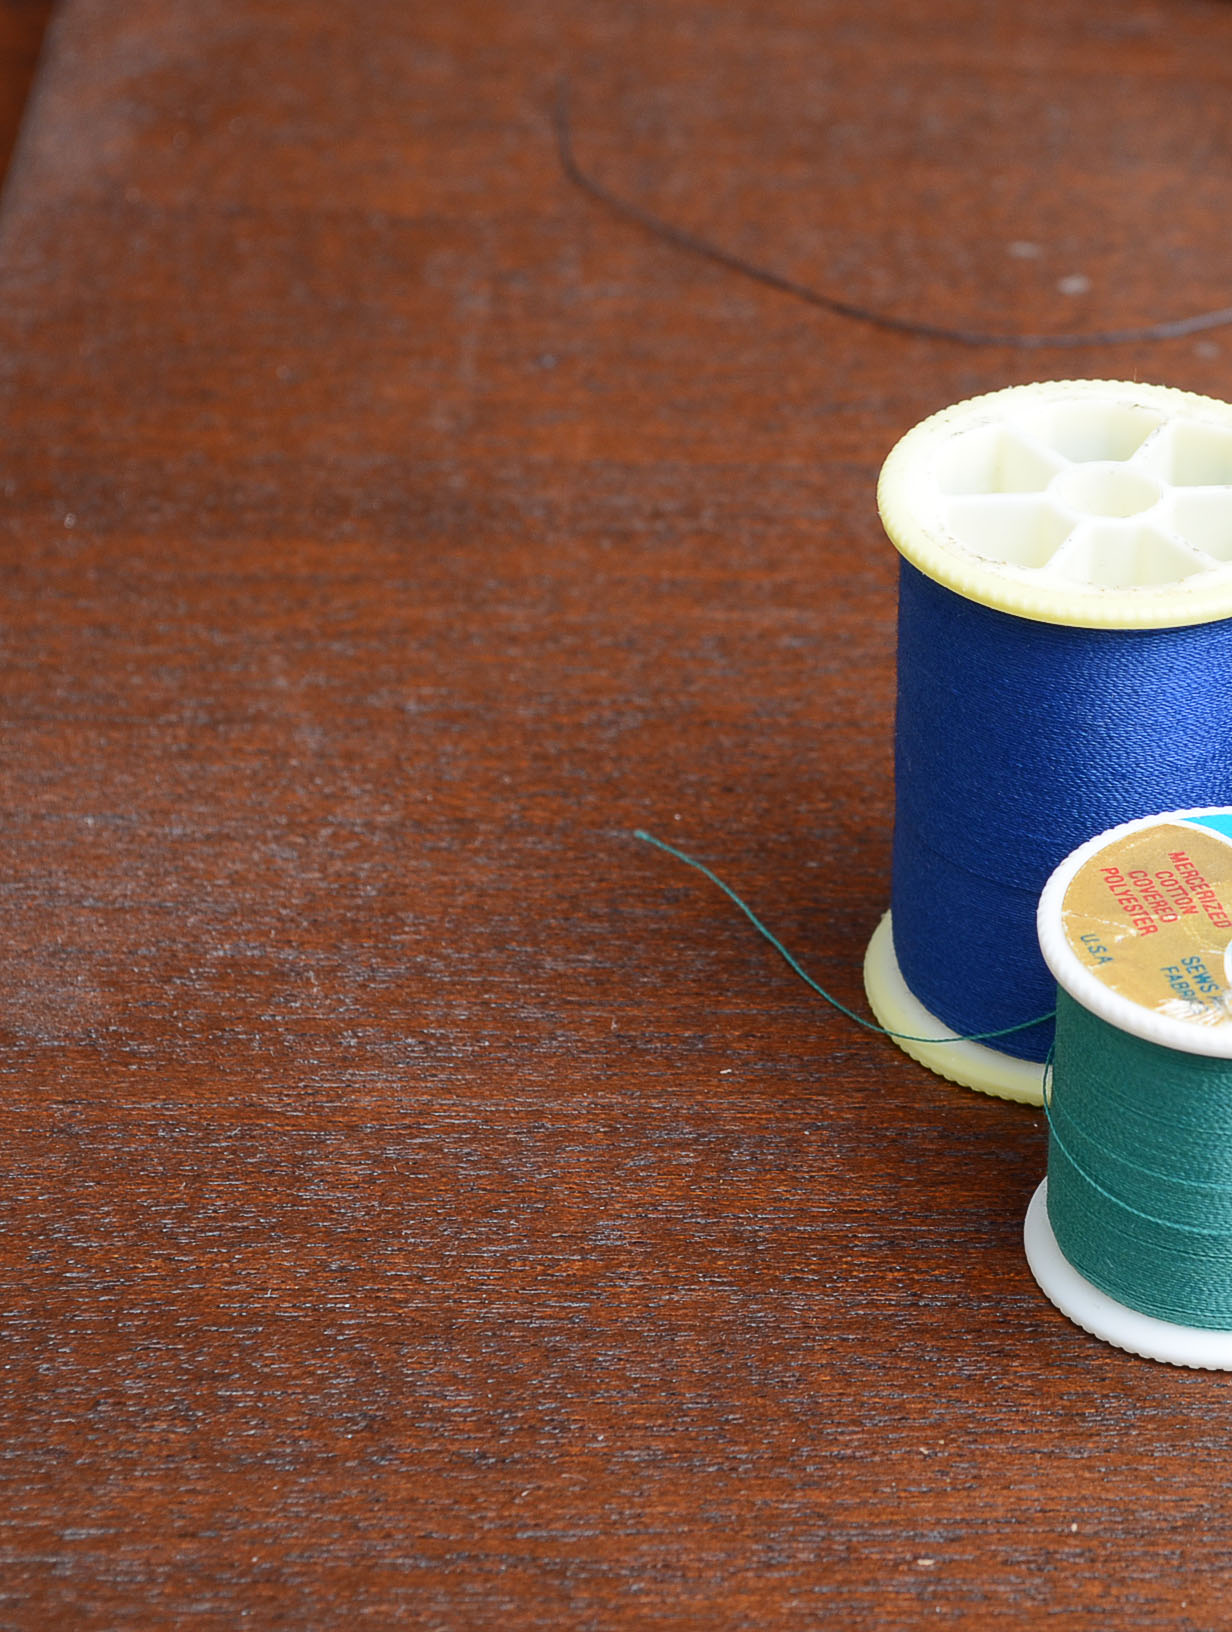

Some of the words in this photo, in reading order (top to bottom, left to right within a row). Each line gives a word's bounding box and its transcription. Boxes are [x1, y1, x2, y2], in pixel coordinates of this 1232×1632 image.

[1099, 867, 1159, 936] POLYESTER
[1127, 870, 1179, 923] COVERED
[1155, 870, 1200, 915] COTTON
[1168, 851, 1232, 929] MERCERIZED
[1181, 955, 1219, 993] SEWS
